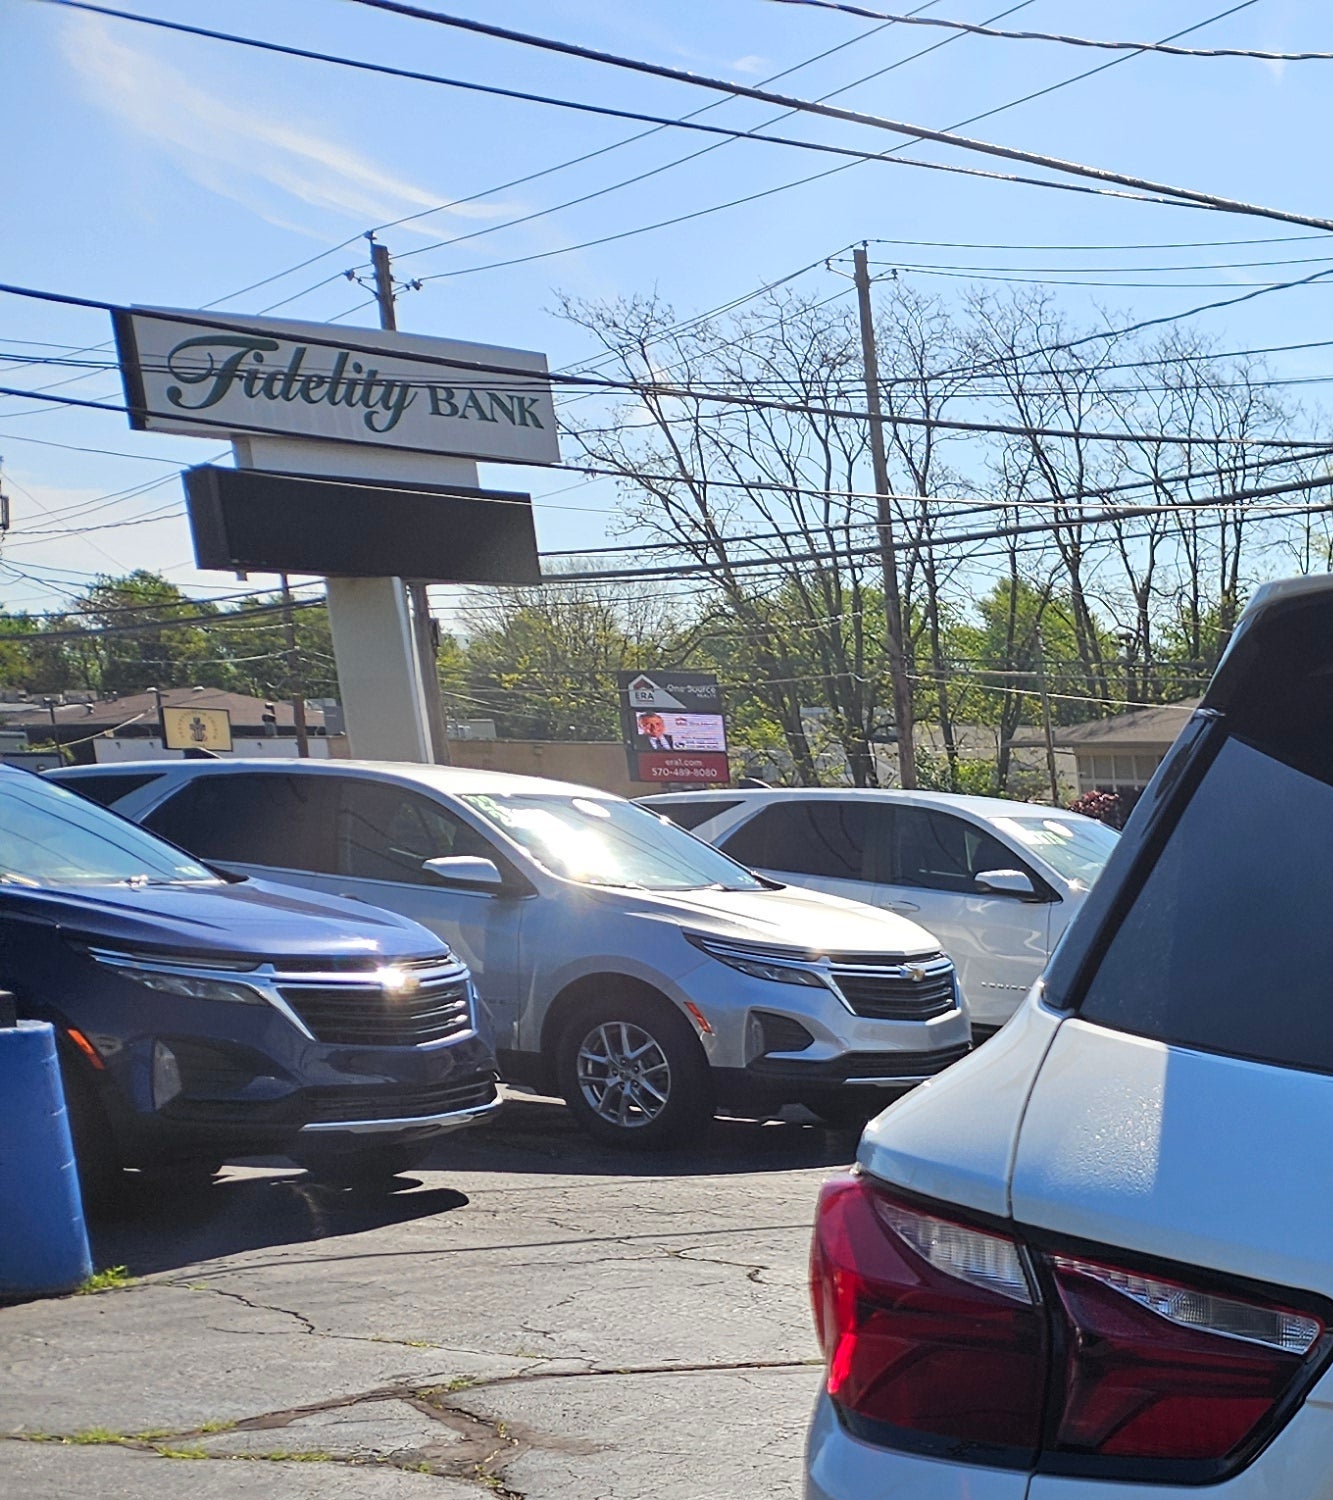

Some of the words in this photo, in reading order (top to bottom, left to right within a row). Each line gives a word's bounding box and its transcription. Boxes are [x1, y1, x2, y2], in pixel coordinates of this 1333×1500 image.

[167, 334, 419, 433] Fidelity
[426, 384, 545, 430] BANK
[687, 684, 717, 694] Source
[634, 691, 655, 700] ERA
[651, 767, 718, 777] 570-489-8080
